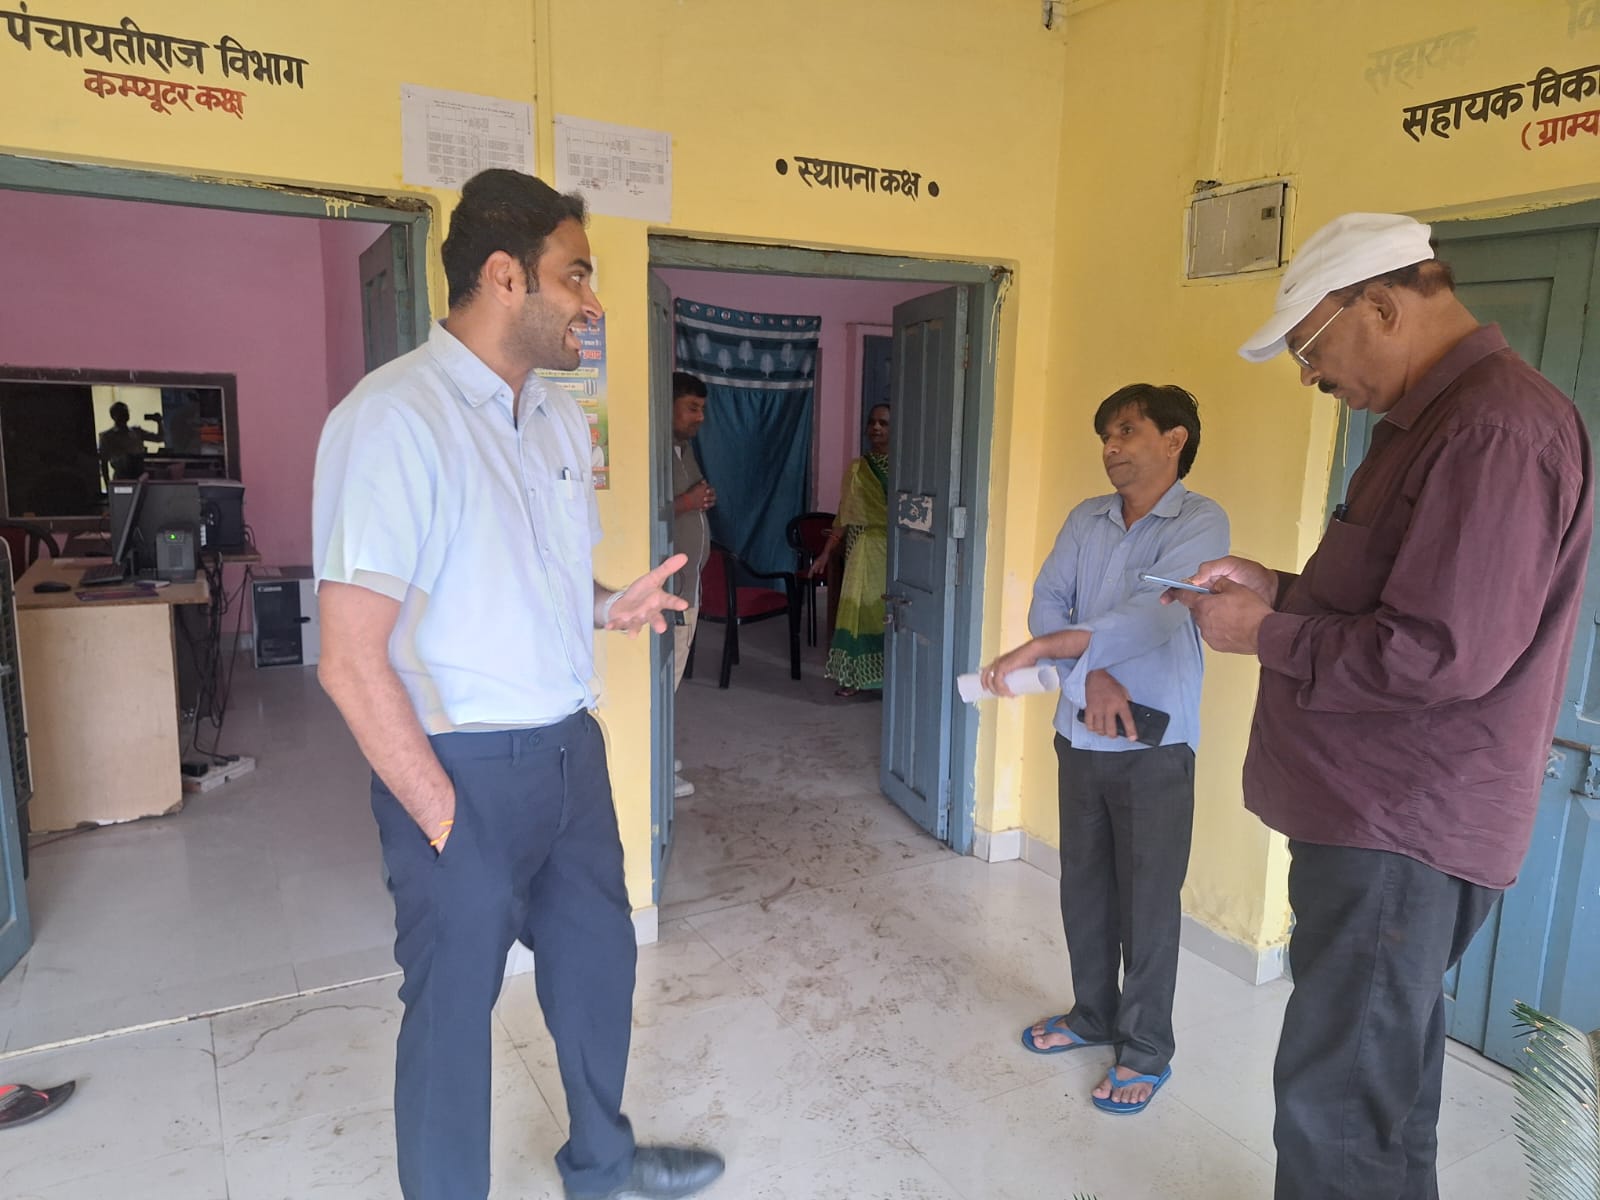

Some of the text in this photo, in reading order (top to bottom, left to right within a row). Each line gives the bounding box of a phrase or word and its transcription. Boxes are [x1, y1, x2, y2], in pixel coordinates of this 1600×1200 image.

[213, 35, 309, 89] विभाग
[196, 86, 247, 120] कक्ष
[1402, 83, 1525, 142] सहायक
[794, 156, 921, 201] स्थापना कक्ष
